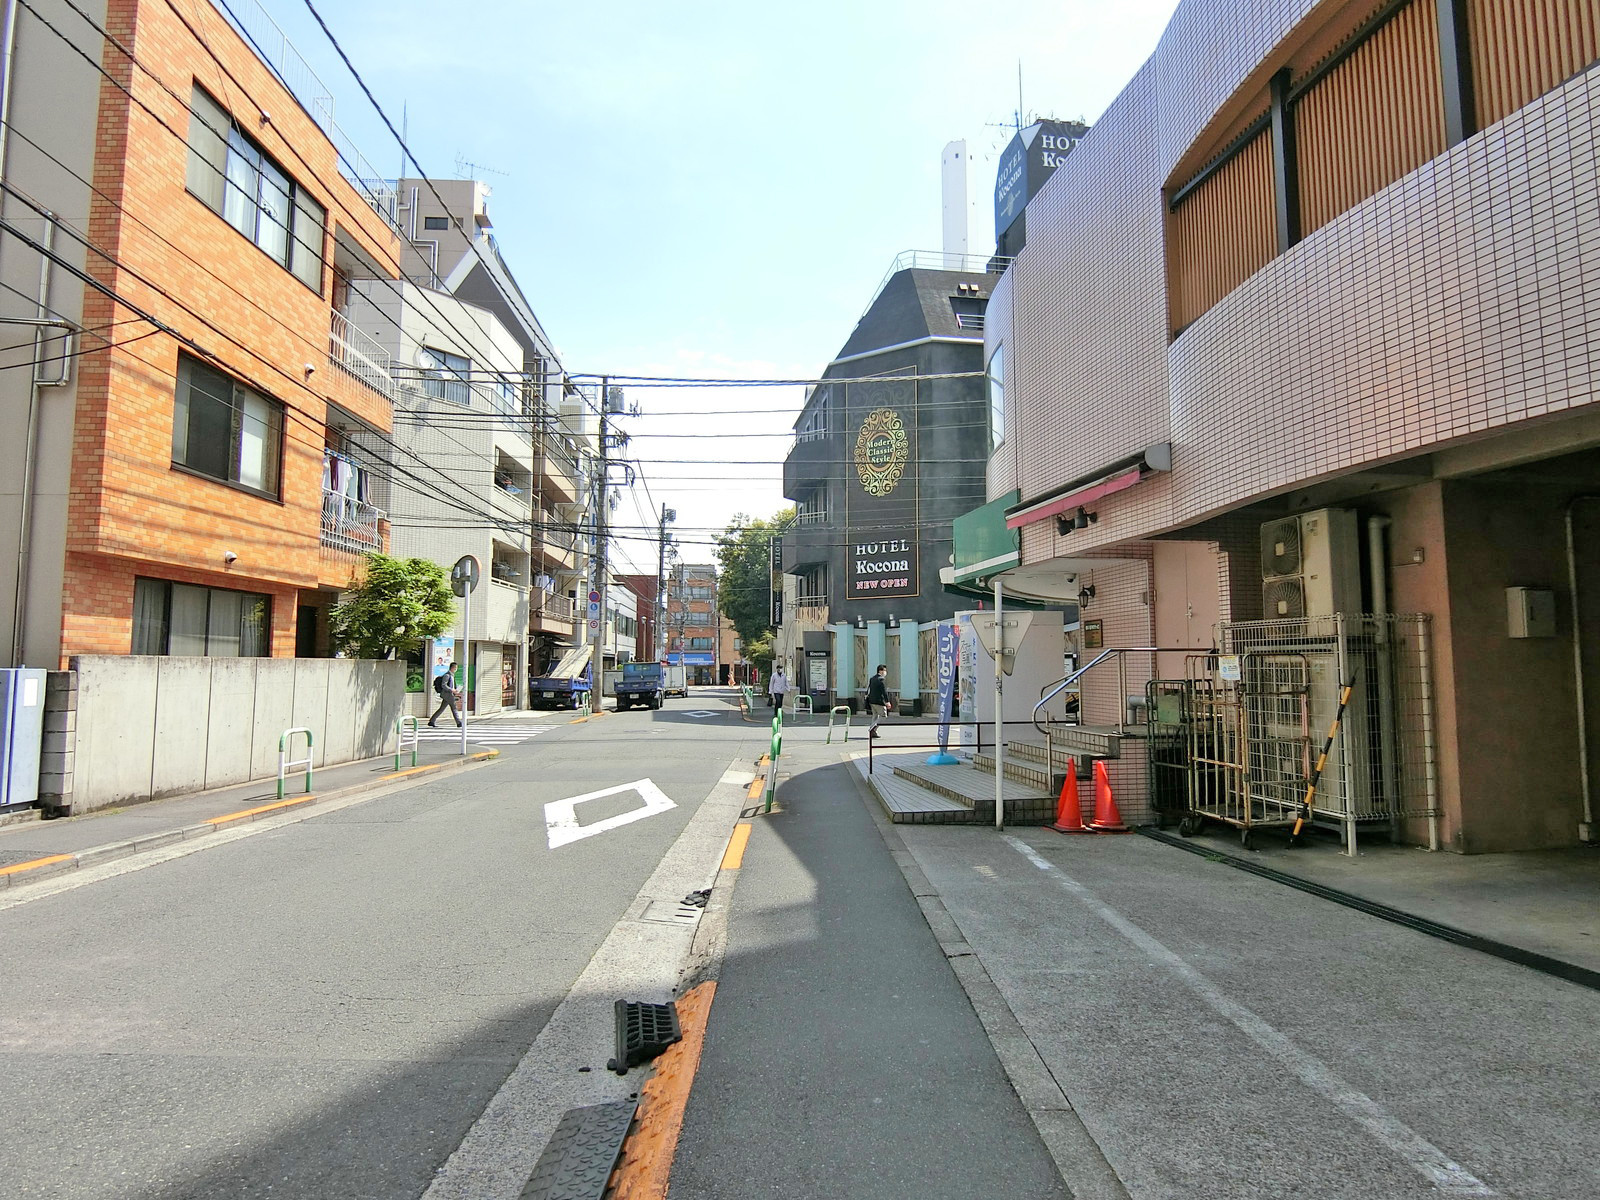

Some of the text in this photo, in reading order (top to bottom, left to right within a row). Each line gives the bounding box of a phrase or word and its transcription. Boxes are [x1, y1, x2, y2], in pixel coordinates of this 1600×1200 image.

[998, 149, 1022, 188] HOTEL
[867, 439, 896, 449] Modern
[868, 447, 894, 457] Classic
[871, 455, 891, 464] Style
[856, 539, 909, 556] HOTEL
[856, 560, 909, 575] Kocona
[856, 578, 908, 590] NEW OPEN
